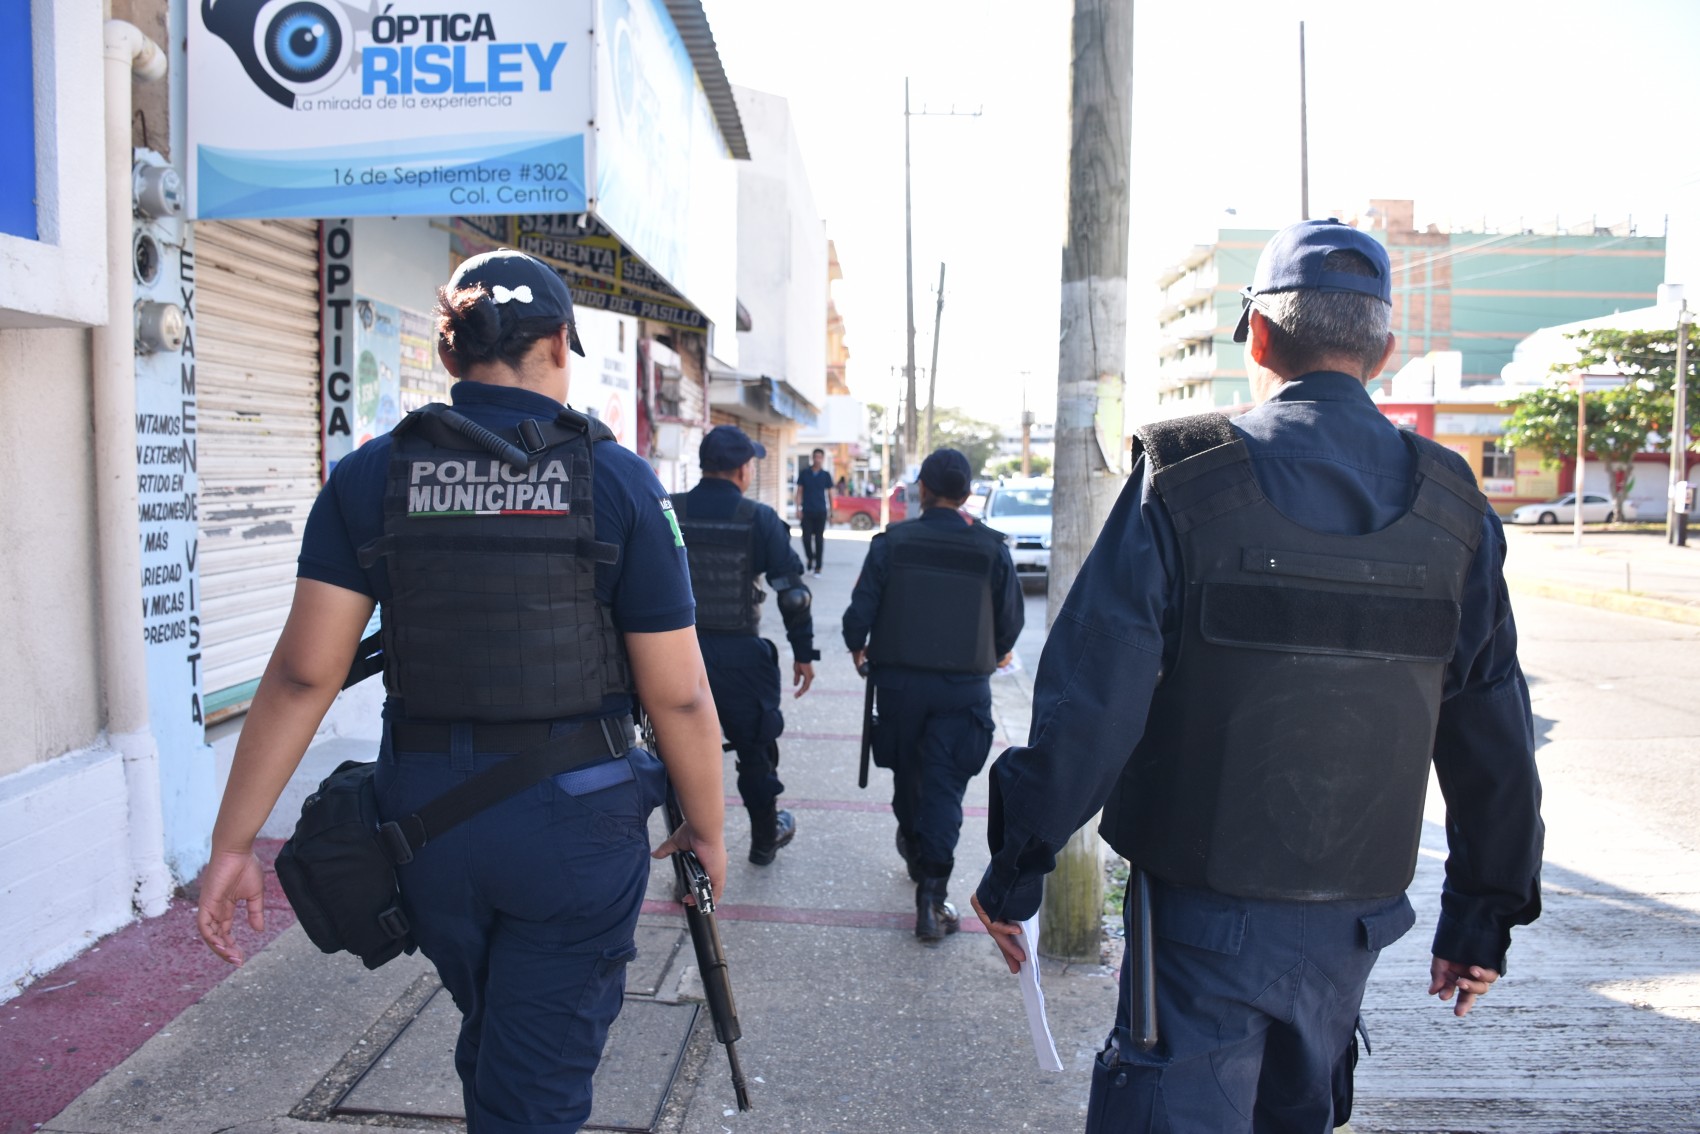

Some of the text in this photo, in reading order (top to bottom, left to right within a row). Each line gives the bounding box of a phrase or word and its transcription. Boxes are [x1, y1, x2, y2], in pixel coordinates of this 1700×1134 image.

[371, 4, 496, 44] ÓPTICA
[362, 42, 568, 95] RISLEY
[295, 93, 512, 111] La mirada de la experiencia
[333, 163, 569, 189] 16 de Septiembre #302
[450, 184, 569, 205] Col. Centro
[519, 235, 617, 268] IMPRENTA
[570, 288, 606, 311] ONDO
[609, 295, 637, 314] DEL
[641, 303, 700, 325] PASILLO
[136, 413, 180, 436] NTAMOS
[137, 474, 170, 493] RTIDO
[409, 484, 570, 512] MUNICIPAL
[138, 501, 185, 523] MAZONES
[141, 563, 182, 587] RIEDAD
[151, 591, 184, 617] MICAS
